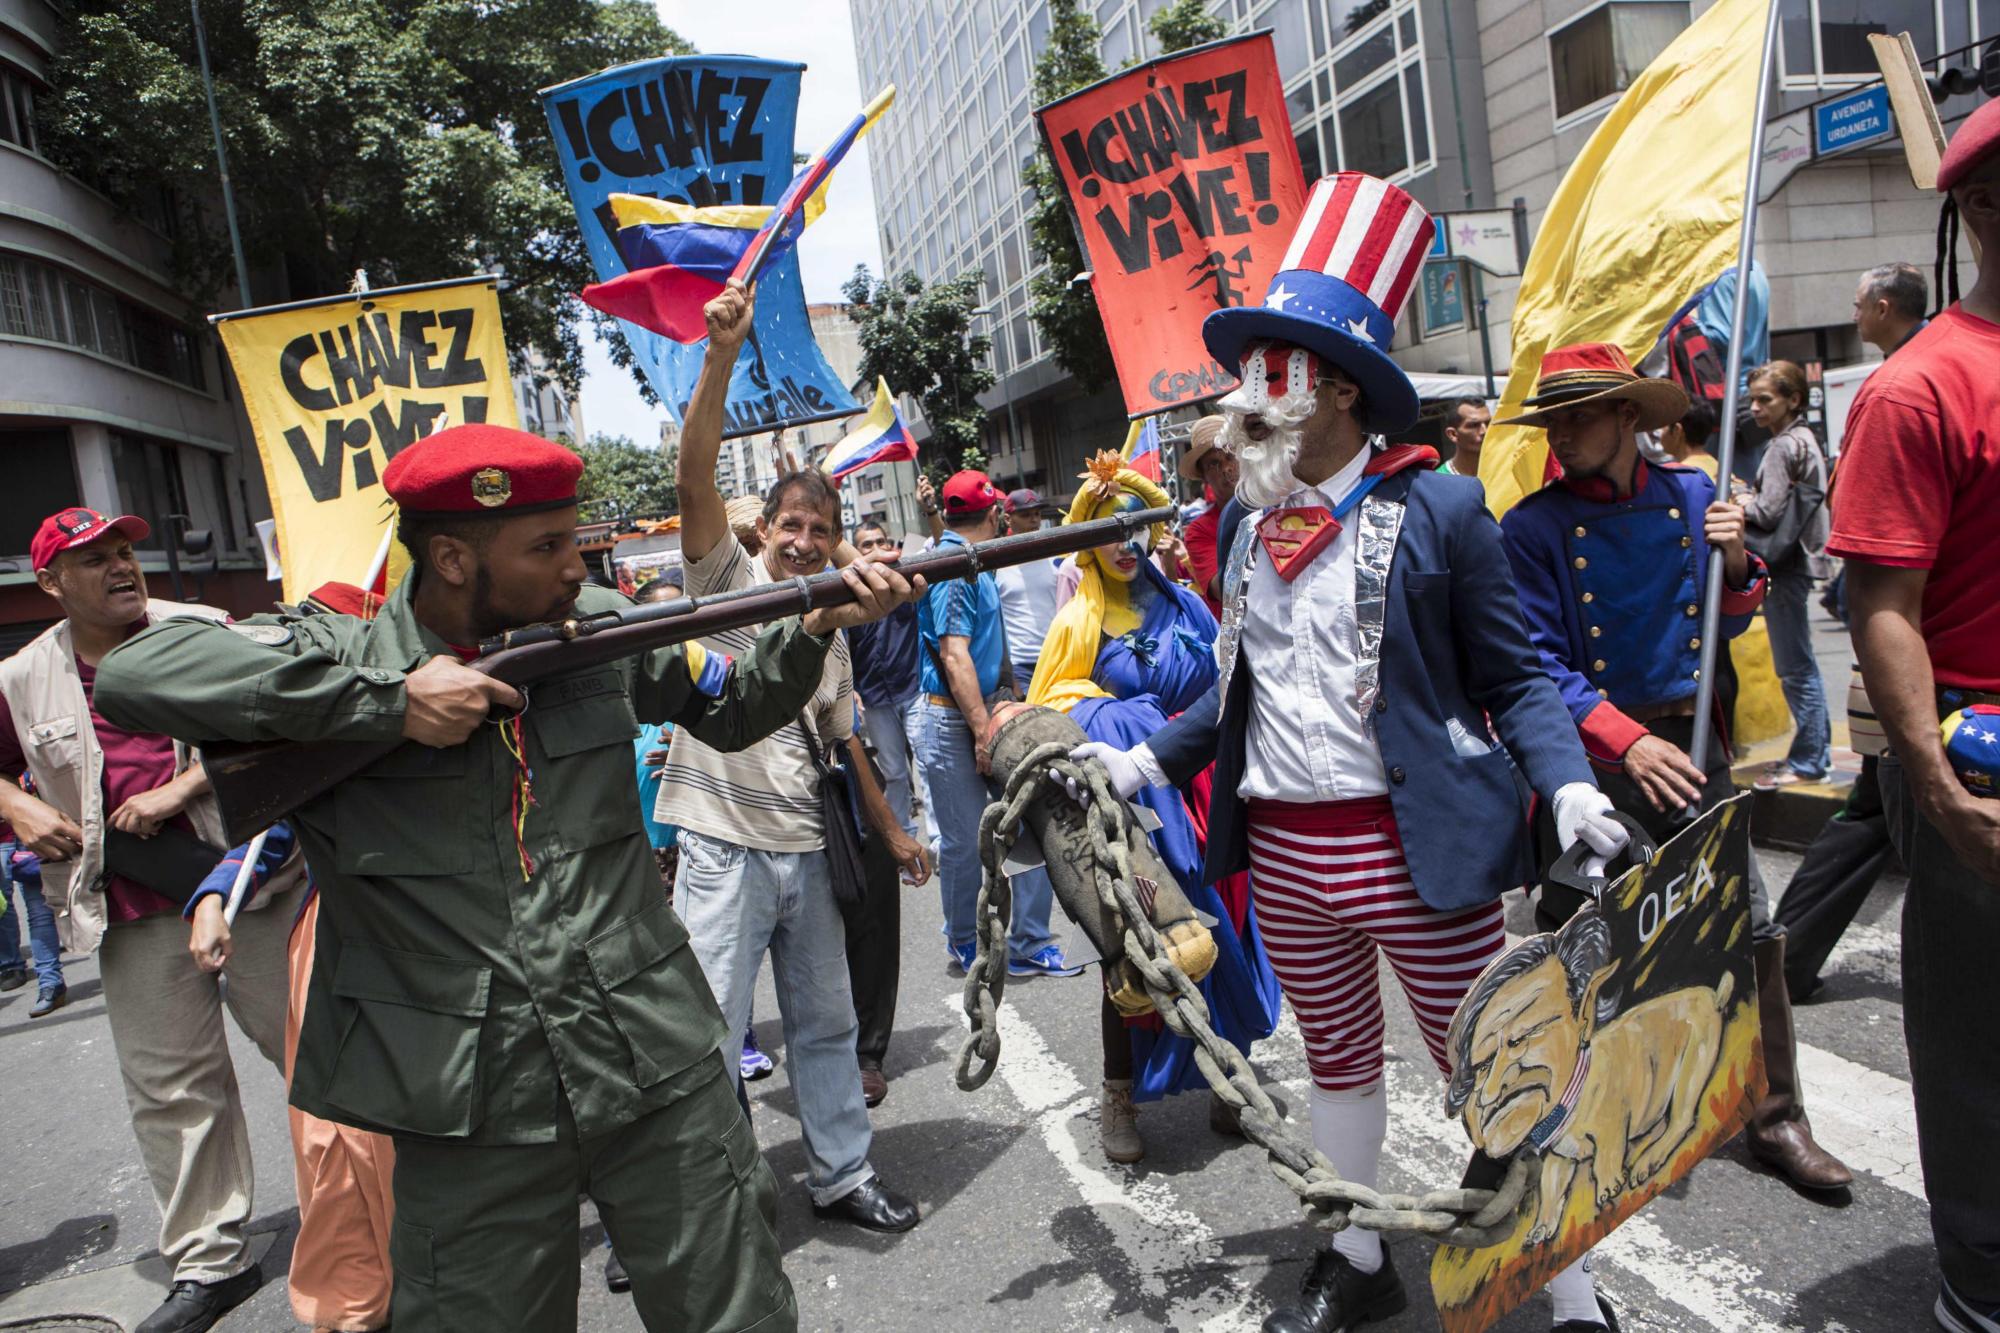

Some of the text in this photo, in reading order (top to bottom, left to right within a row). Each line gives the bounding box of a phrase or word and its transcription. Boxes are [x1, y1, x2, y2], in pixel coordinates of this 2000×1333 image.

[1831, 99, 1874, 122] AVENIDA
[1827, 117, 1880, 142] URDANETA
[72, 521, 92, 534] CHE
[560, 678, 604, 699] FANB
[1638, 858, 1715, 943] OEA
